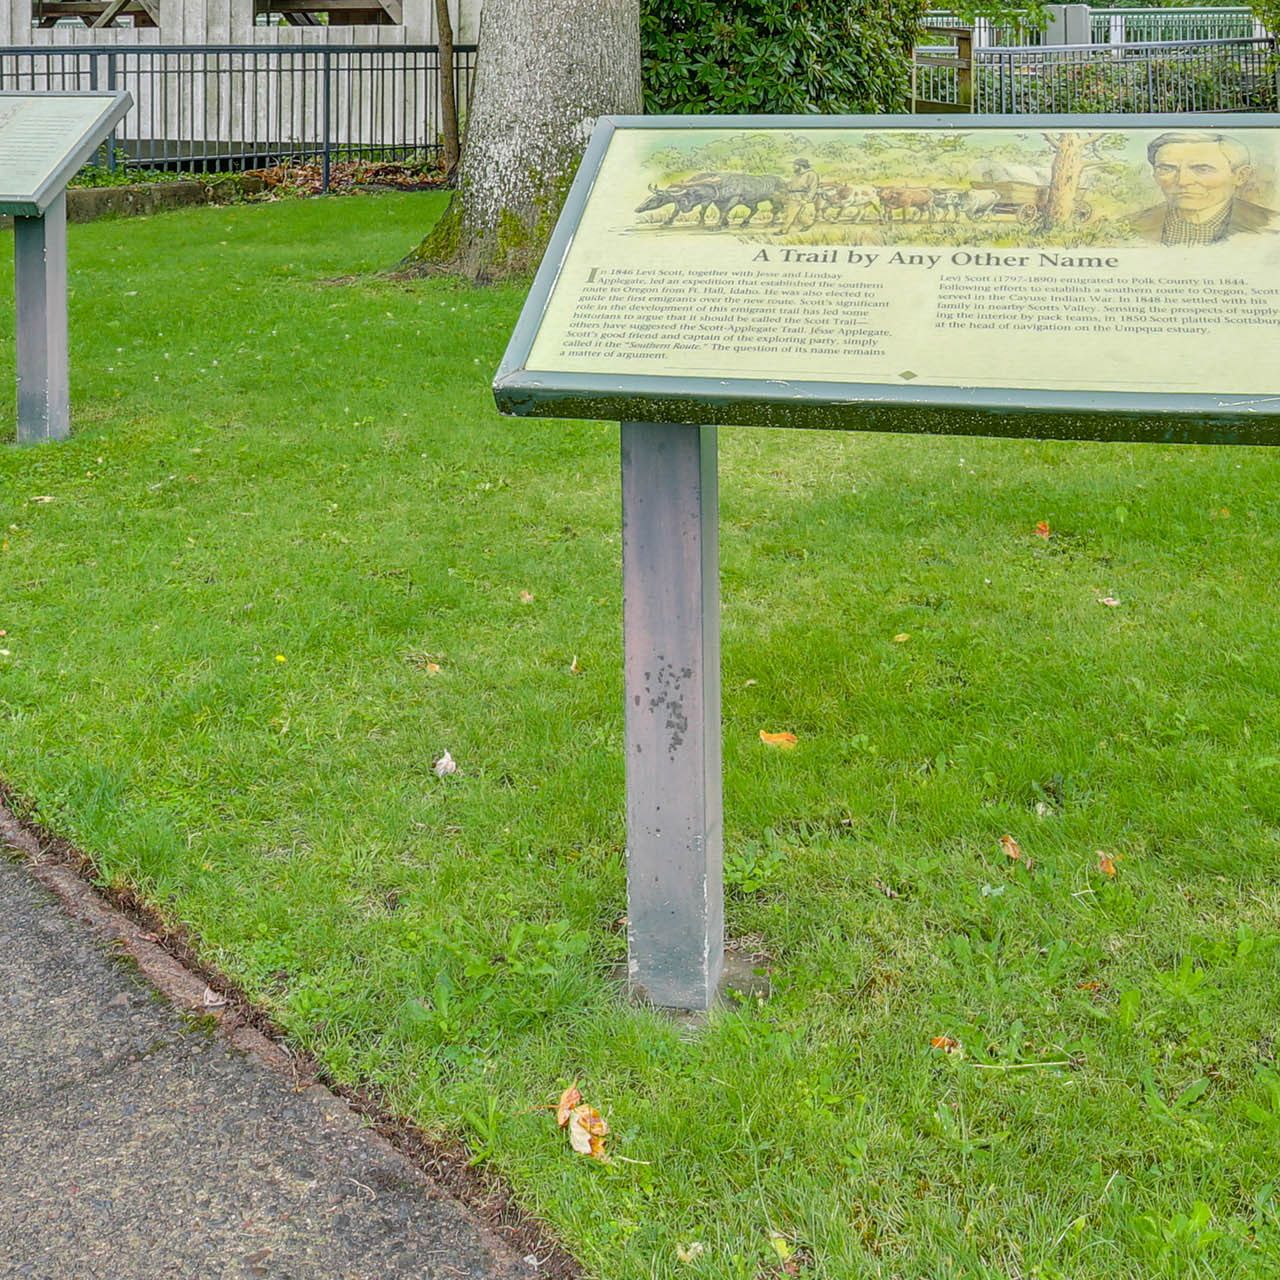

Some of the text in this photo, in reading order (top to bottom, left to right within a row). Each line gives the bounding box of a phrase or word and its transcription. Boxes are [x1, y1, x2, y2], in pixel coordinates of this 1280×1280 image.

[751, 248, 1119, 269] A Trail by Any Other Name
[687, 270, 728, 278] together
[804, 272, 842, 280] Lindsay
[993, 275, 1057, 283] (1797-1890)
[1060, 276, 1113, 285] emigrated
[1157, 277, 1199, 286] County
[681, 278, 734, 287] expedition
[622, 286, 658, 295] Oregon
[938, 283, 990, 293] Following
[1202, 287, 1247, 296] Oregon,
[577, 294, 606, 303] guide
[647, 296, 696, 305] emigrants
[835, 299, 889, 309] significant
[1008, 294, 1047, 303] Cayuse
[627, 304, 693, 314] development
[730, 306, 776, 316] emigrant
[936, 302, 970, 311] family
[988, 303, 1024, 312] nearby
[1103, 305, 1145, 314] Sensing
[1170, 307, 1223, 316] prospects
[1037, 313, 1062, 322] pack
[1181, 316, 1220, 325] platted
[628, 323, 677, 332] suggested
[697, 324, 777, 334] Scott-Applegate
[1013, 322, 1071, 333] navigation
[1114, 324, 1163, 334] Umpqua
[599, 331, 626, 340] good
[682, 333, 720, 343] captain
[755, 335, 806, 345] exploring
[842, 337, 878, 347] simply
[732, 344, 778, 354] question
[615, 352, 669, 361] argument.
